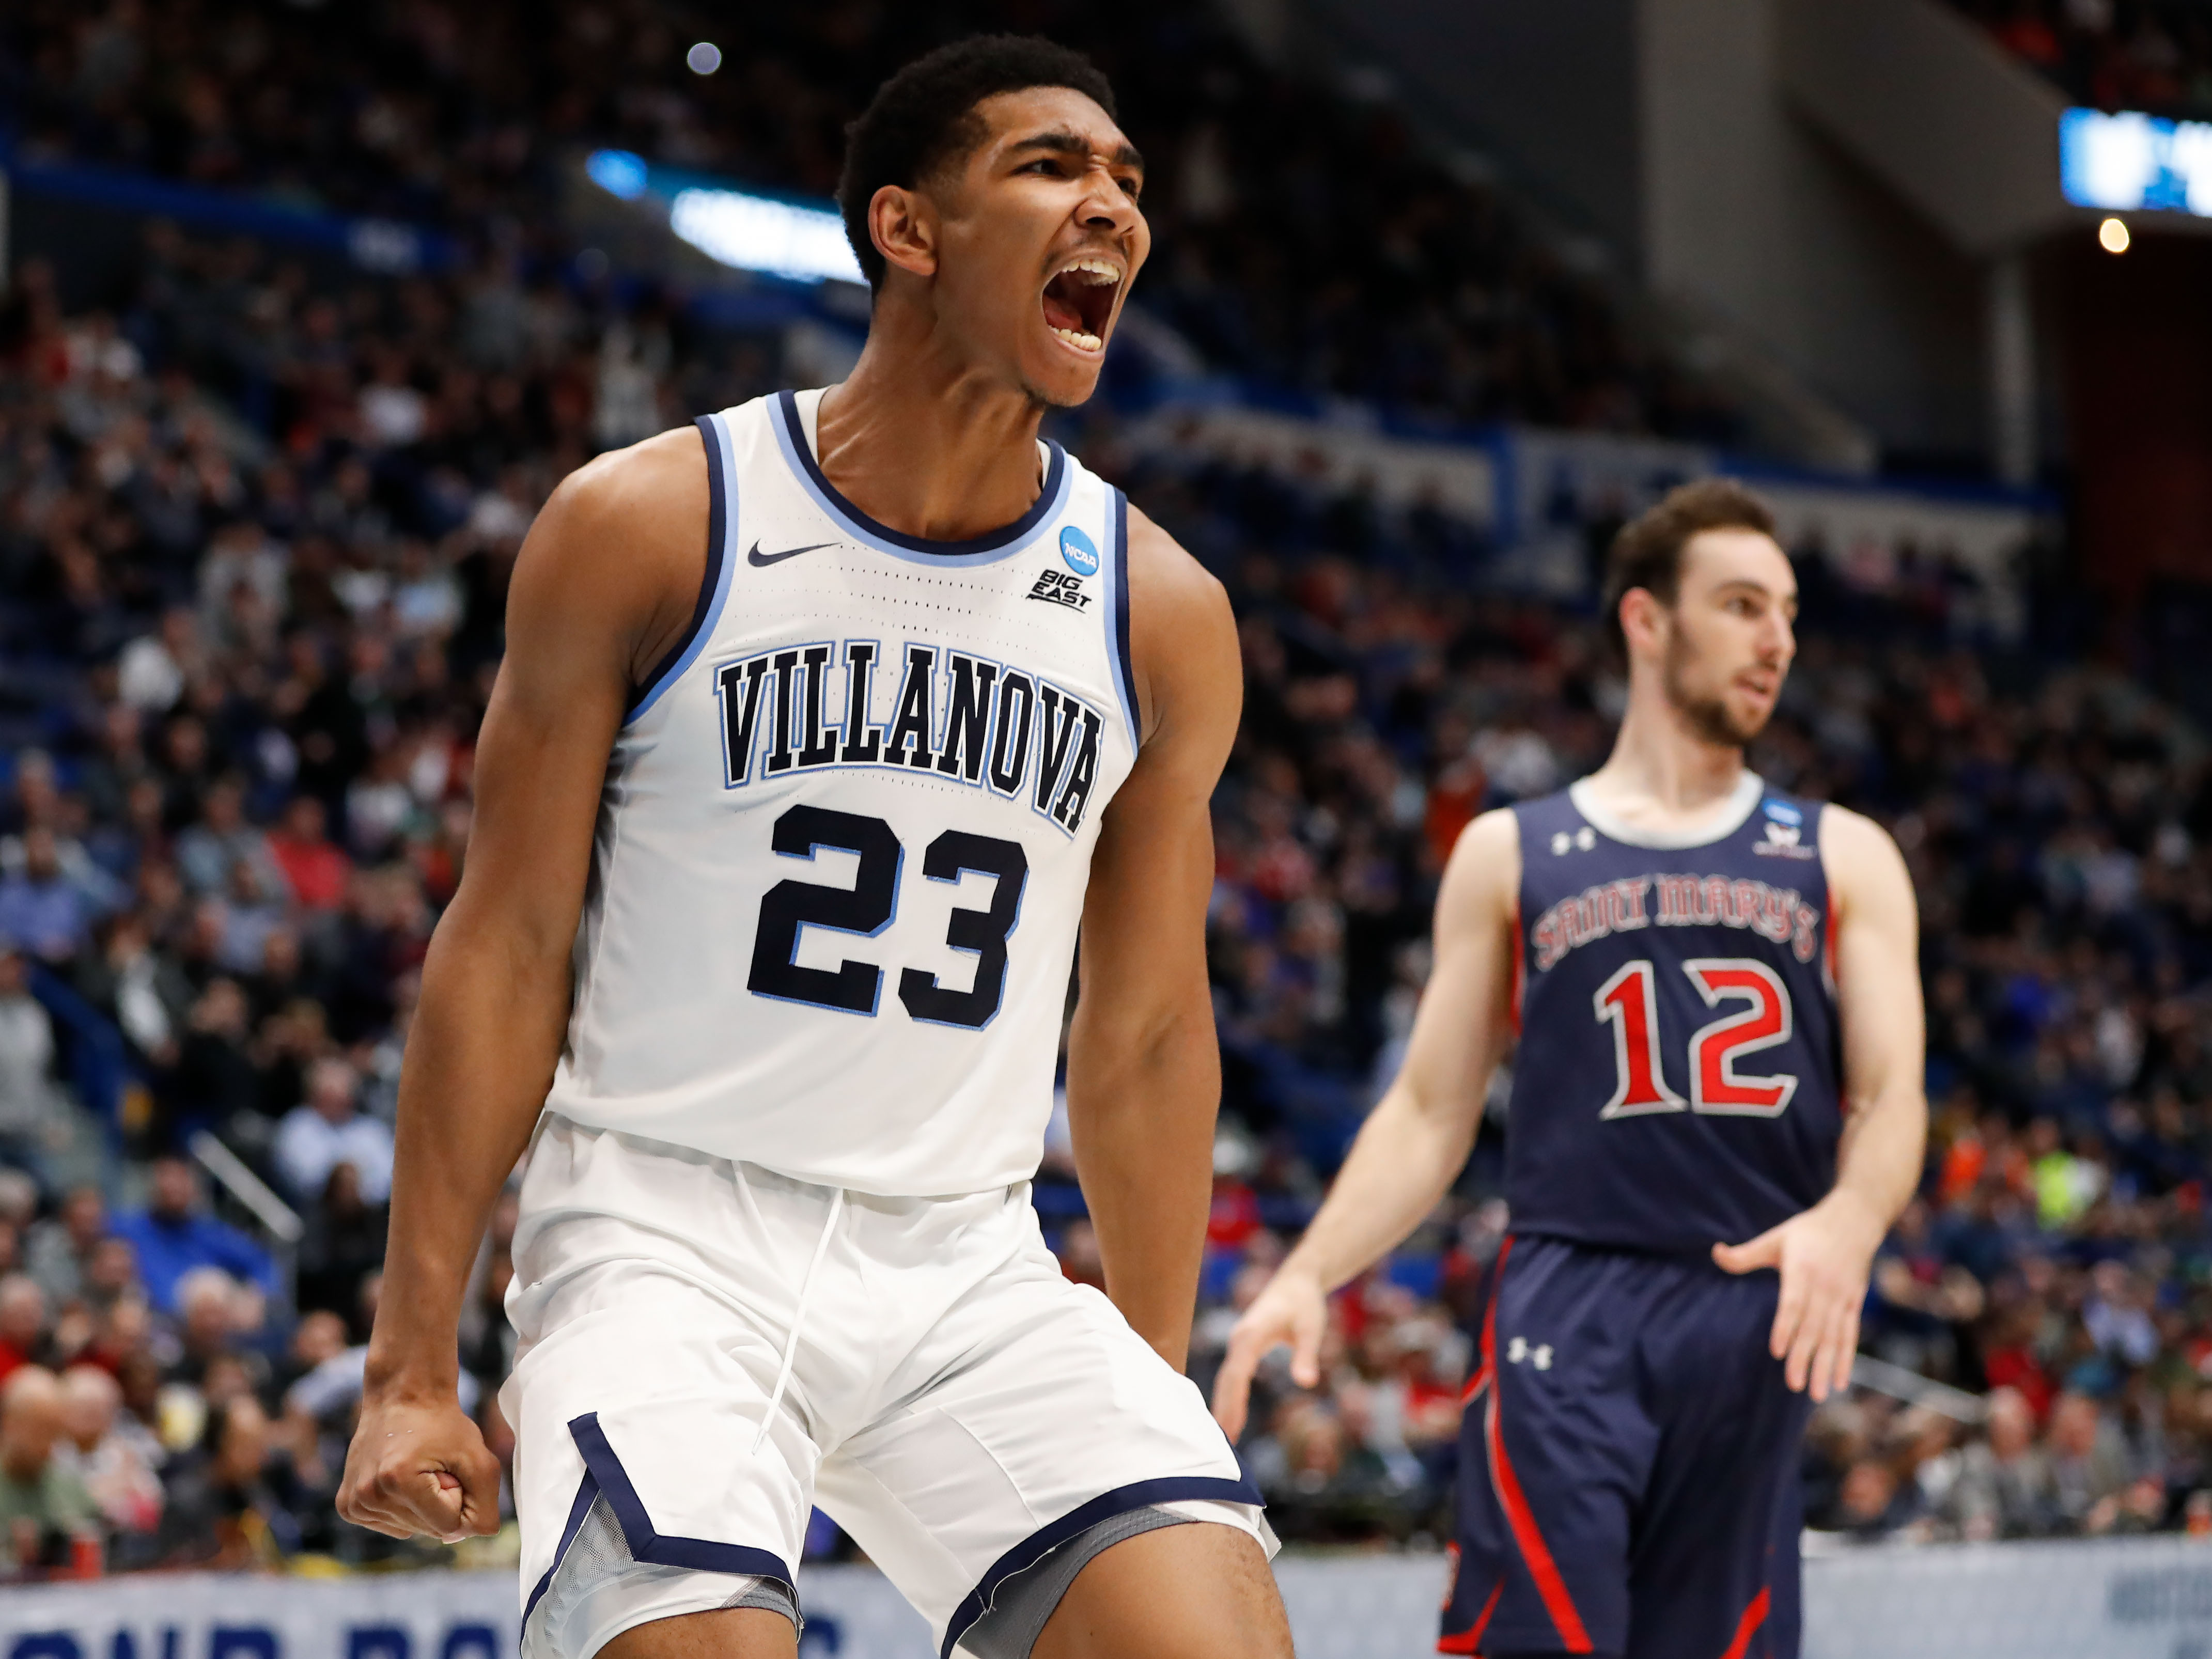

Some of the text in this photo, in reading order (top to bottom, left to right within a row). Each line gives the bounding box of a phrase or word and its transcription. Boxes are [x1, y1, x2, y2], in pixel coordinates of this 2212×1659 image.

[1031, 581, 1092, 607] EAST
[1039, 569, 1083, 590] BIG
[1065, 542, 1097, 568] NCAA
[713, 639, 1107, 841] VILLANOVA
[747, 804, 1030, 1032] 23
[1531, 873, 1653, 972] SAINT
[1593, 959, 1799, 1120] 12
